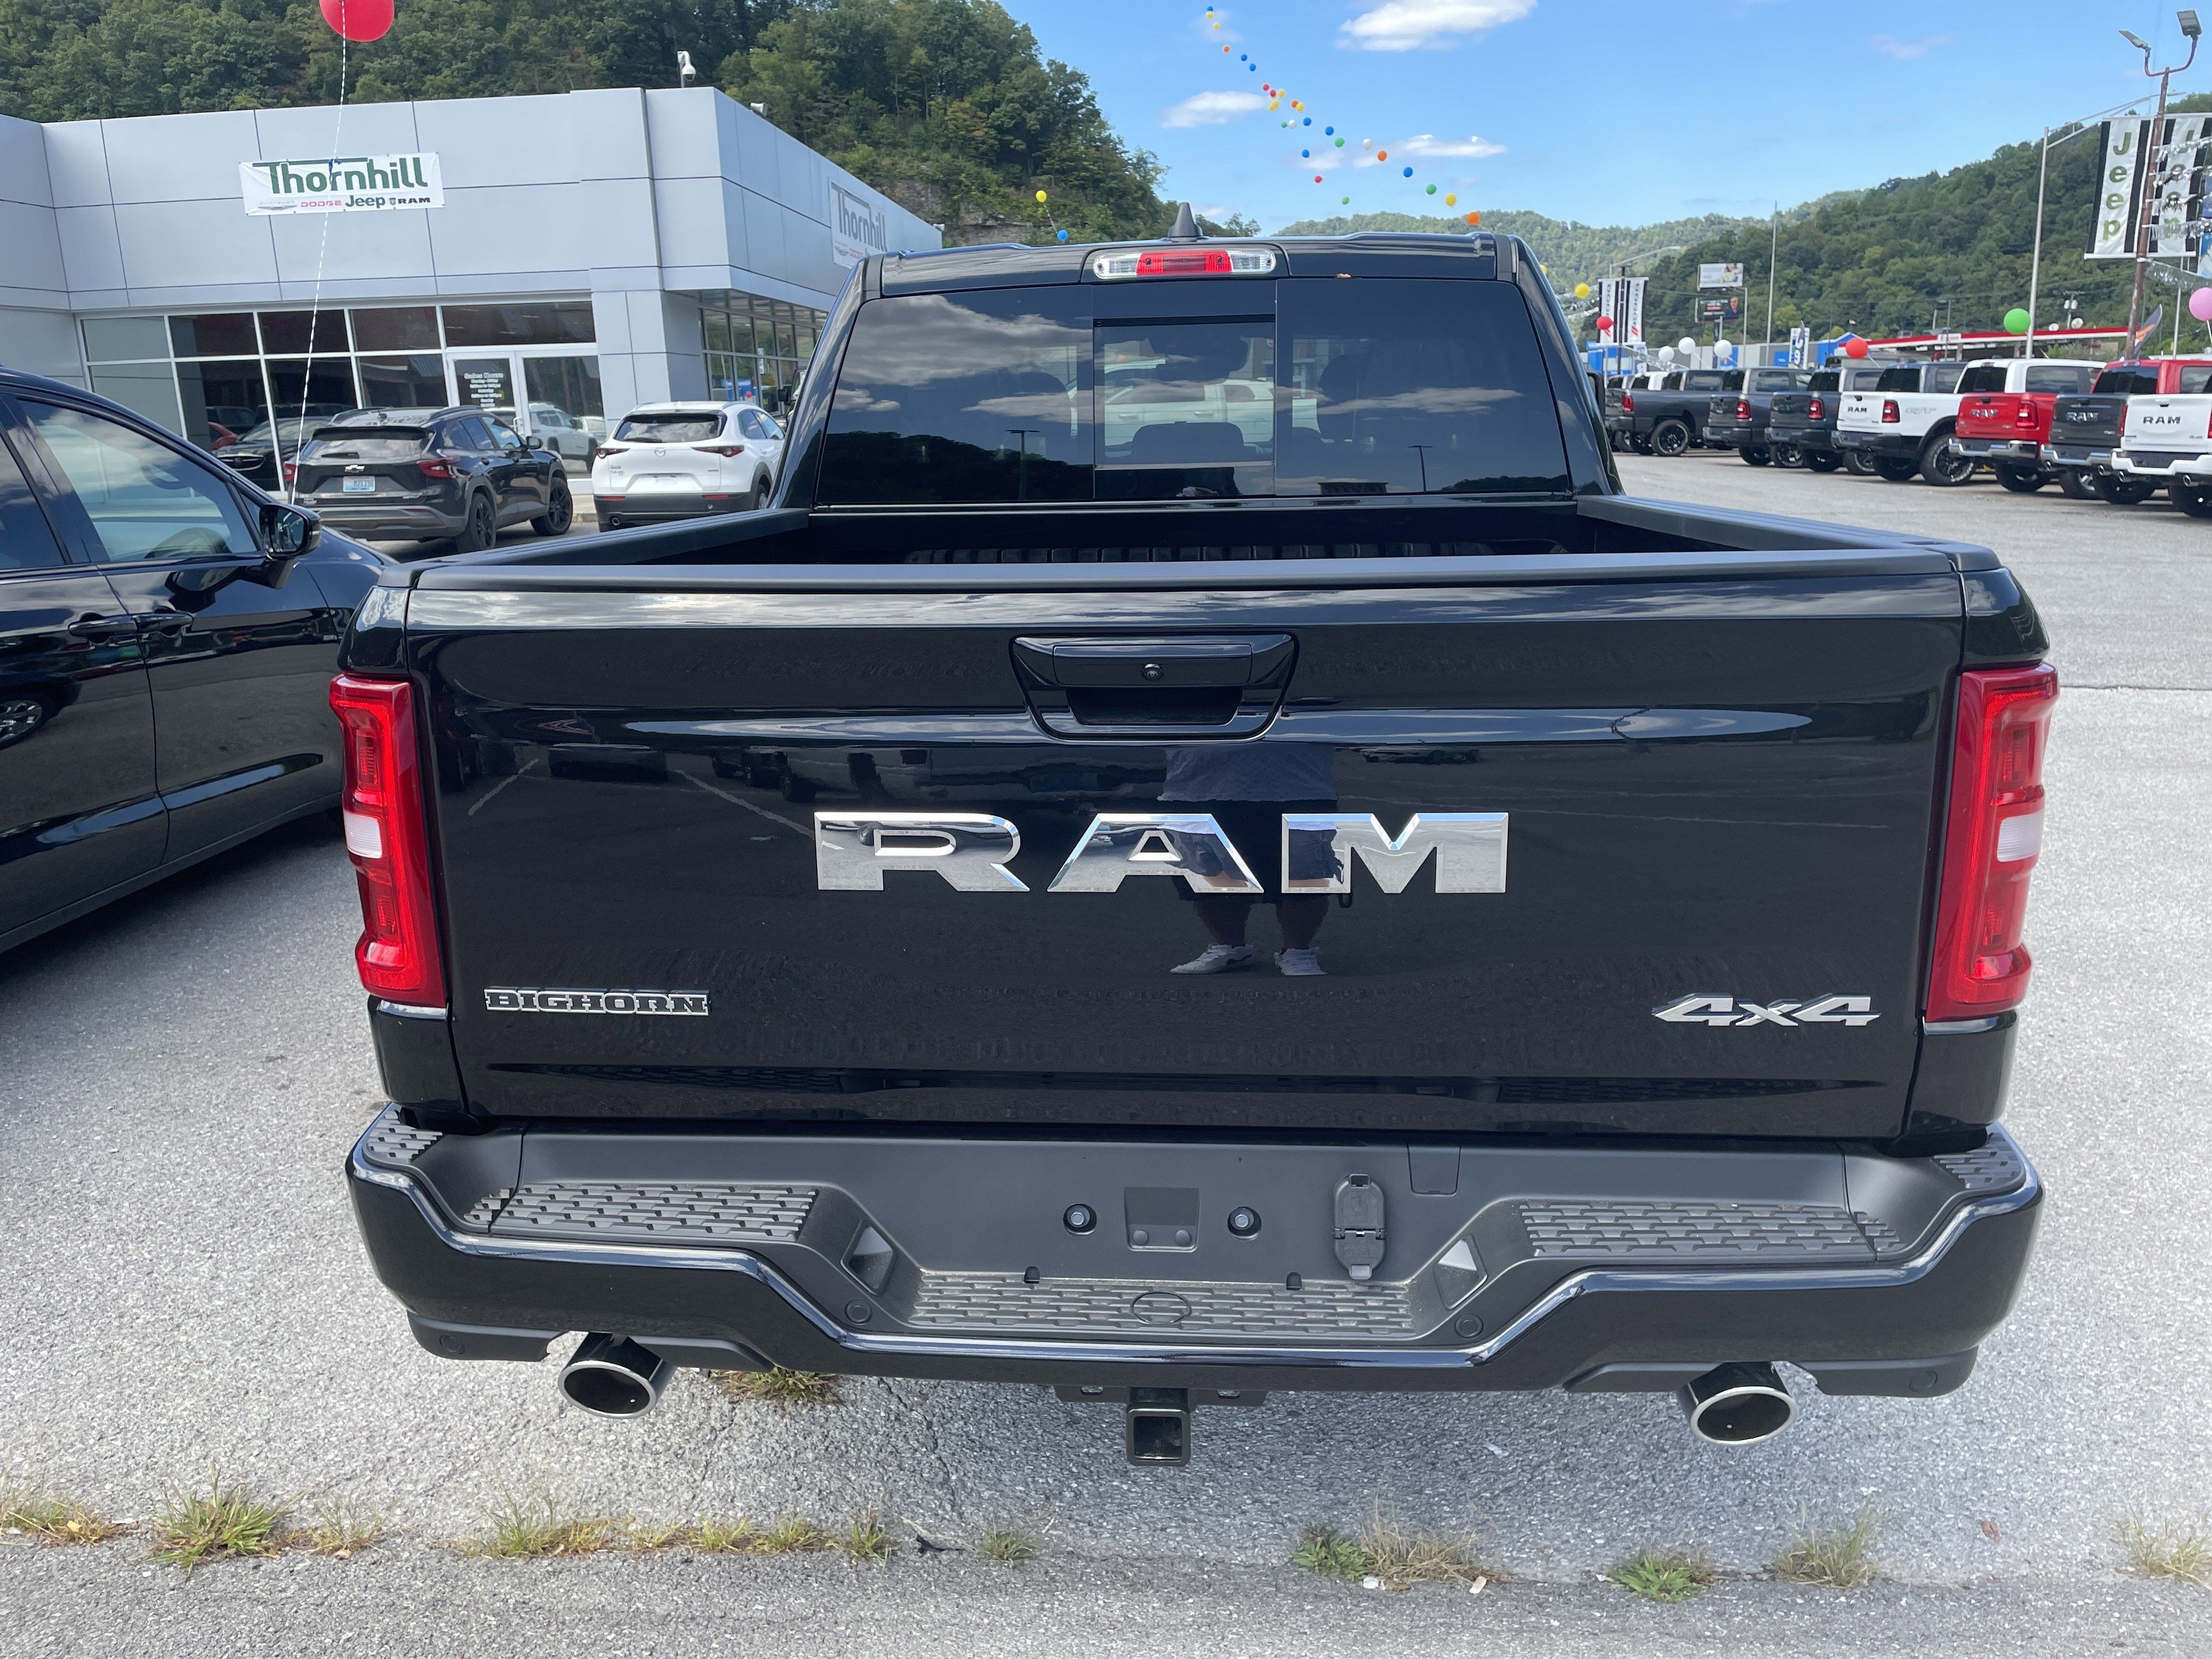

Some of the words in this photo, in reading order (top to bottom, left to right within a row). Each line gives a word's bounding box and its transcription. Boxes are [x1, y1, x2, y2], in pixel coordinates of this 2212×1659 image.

[252, 157, 428, 194] Thornhill
[2103, 132, 2132, 240] Jeep
[345, 195, 386, 208] Jeep
[831, 182, 887, 252] Thornhill
[814, 811, 1509, 894] RAM
[484, 989, 709, 1016] BIGHORN
[1652, 994, 1881, 1026] 4x4
